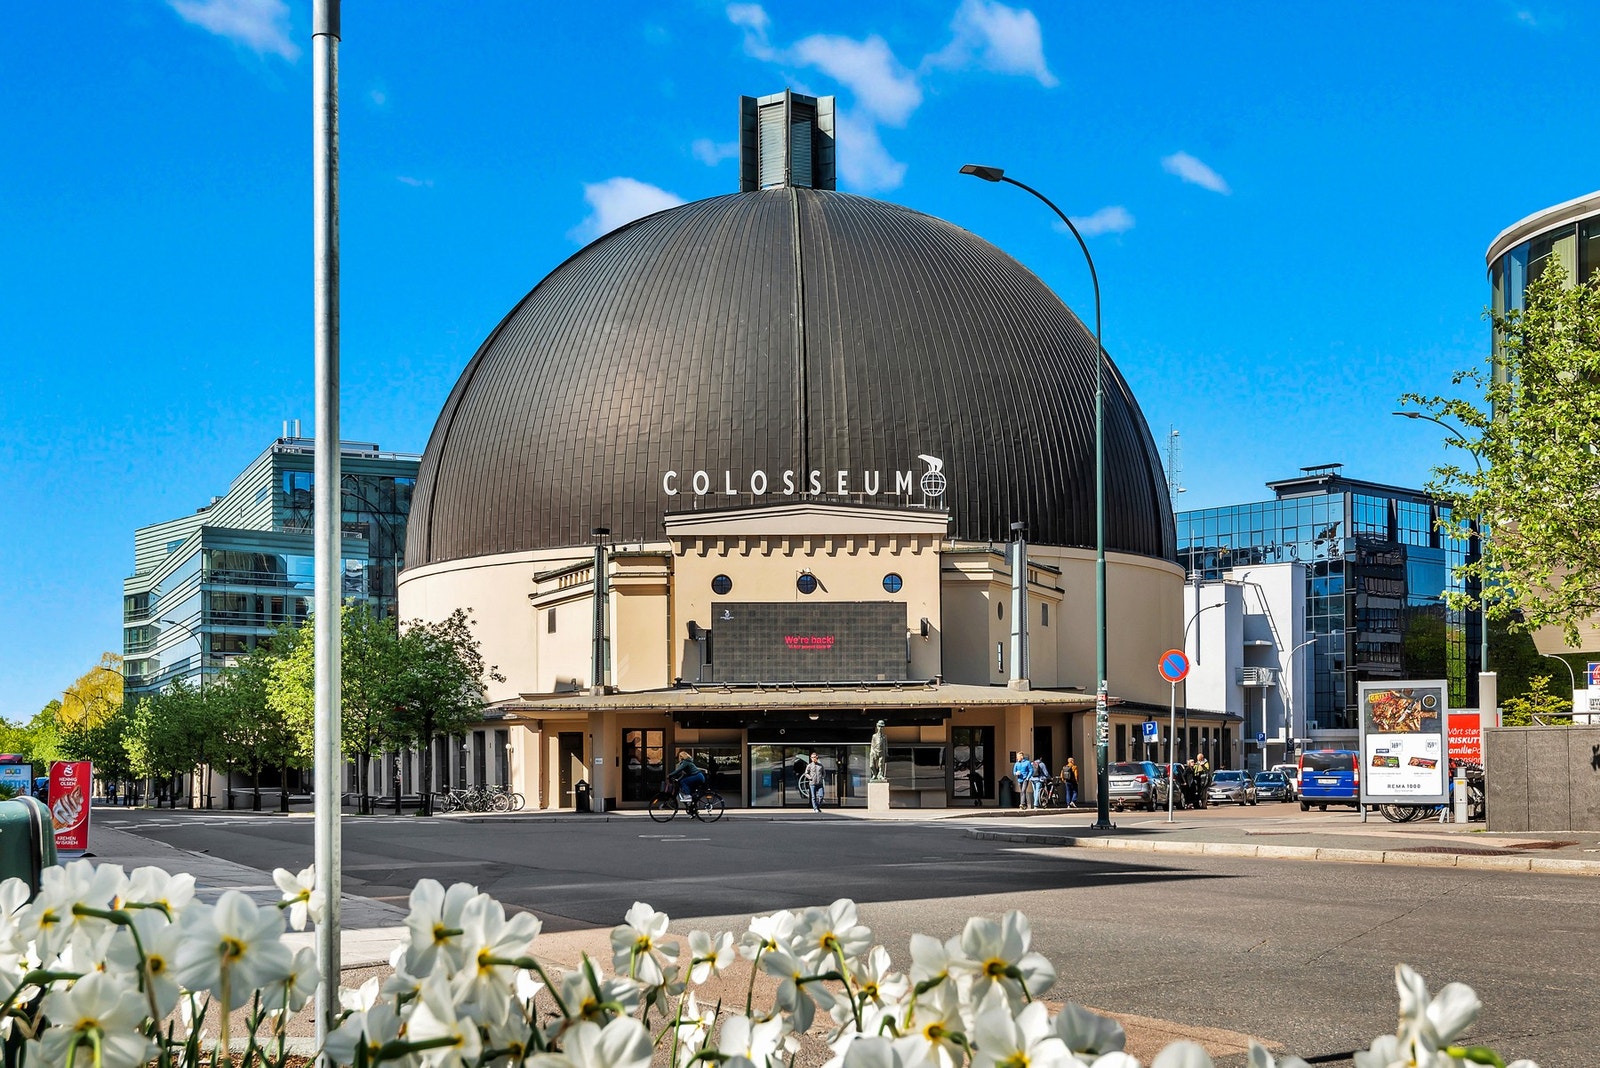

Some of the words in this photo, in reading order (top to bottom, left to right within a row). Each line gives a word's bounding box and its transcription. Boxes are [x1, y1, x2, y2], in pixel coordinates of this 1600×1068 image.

[663, 470, 913, 496] COLOSSEUM
[785, 635, 809, 644] We're
[811, 635, 834, 644] back!
[1146, 723, 1154, 734] P
